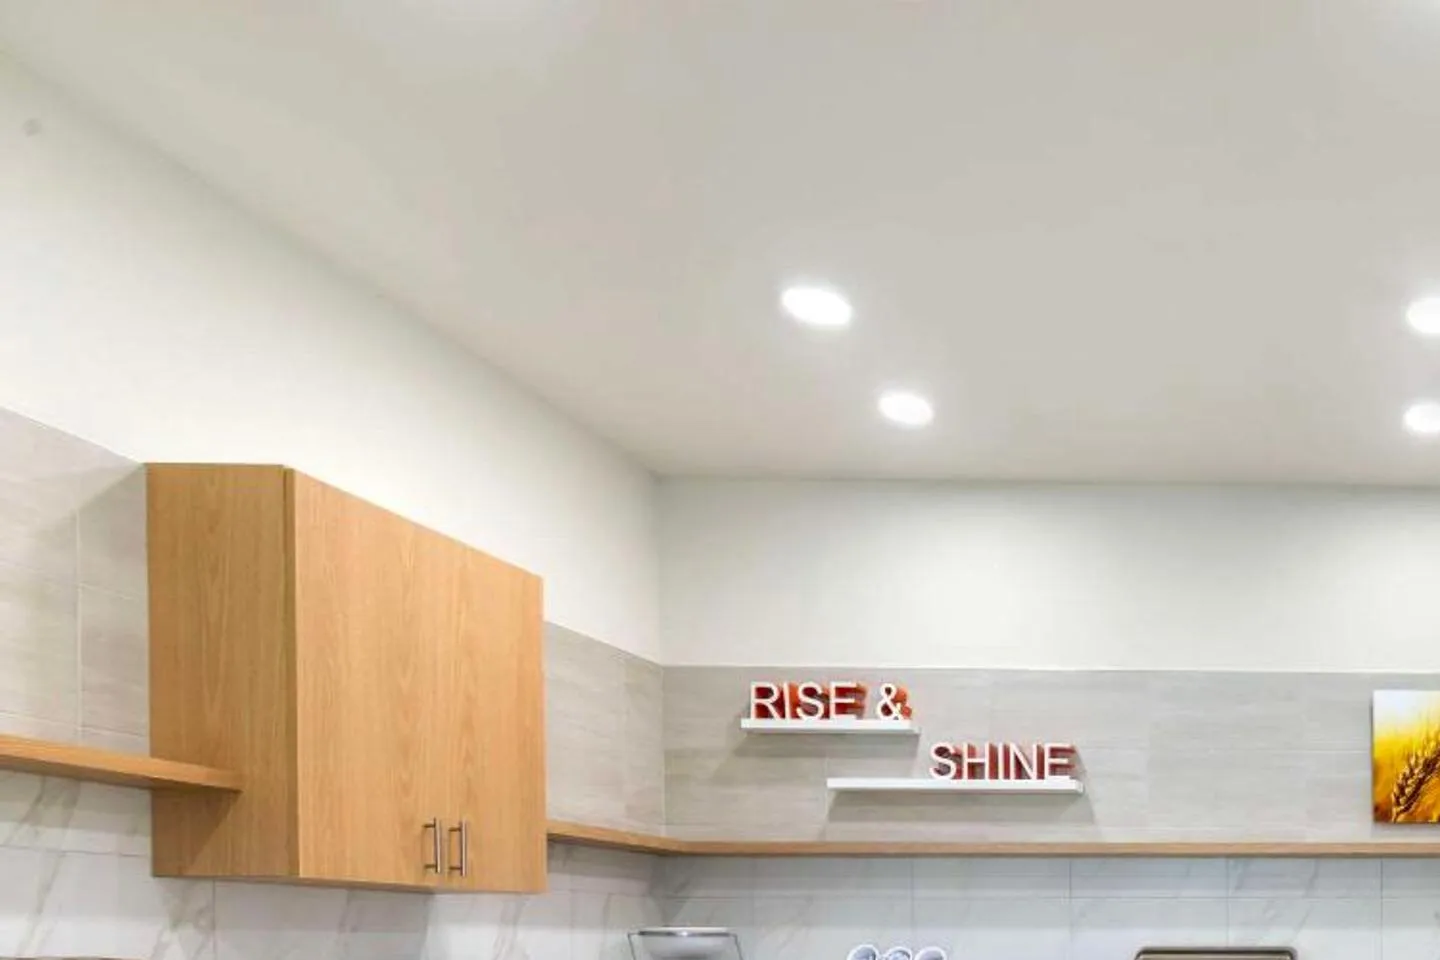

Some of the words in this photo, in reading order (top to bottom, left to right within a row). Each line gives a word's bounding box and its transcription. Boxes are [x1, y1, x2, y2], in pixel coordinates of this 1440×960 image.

[751, 681, 862, 720] RISE
[876, 682, 908, 720] &
[929, 742, 1074, 780] SHINE
